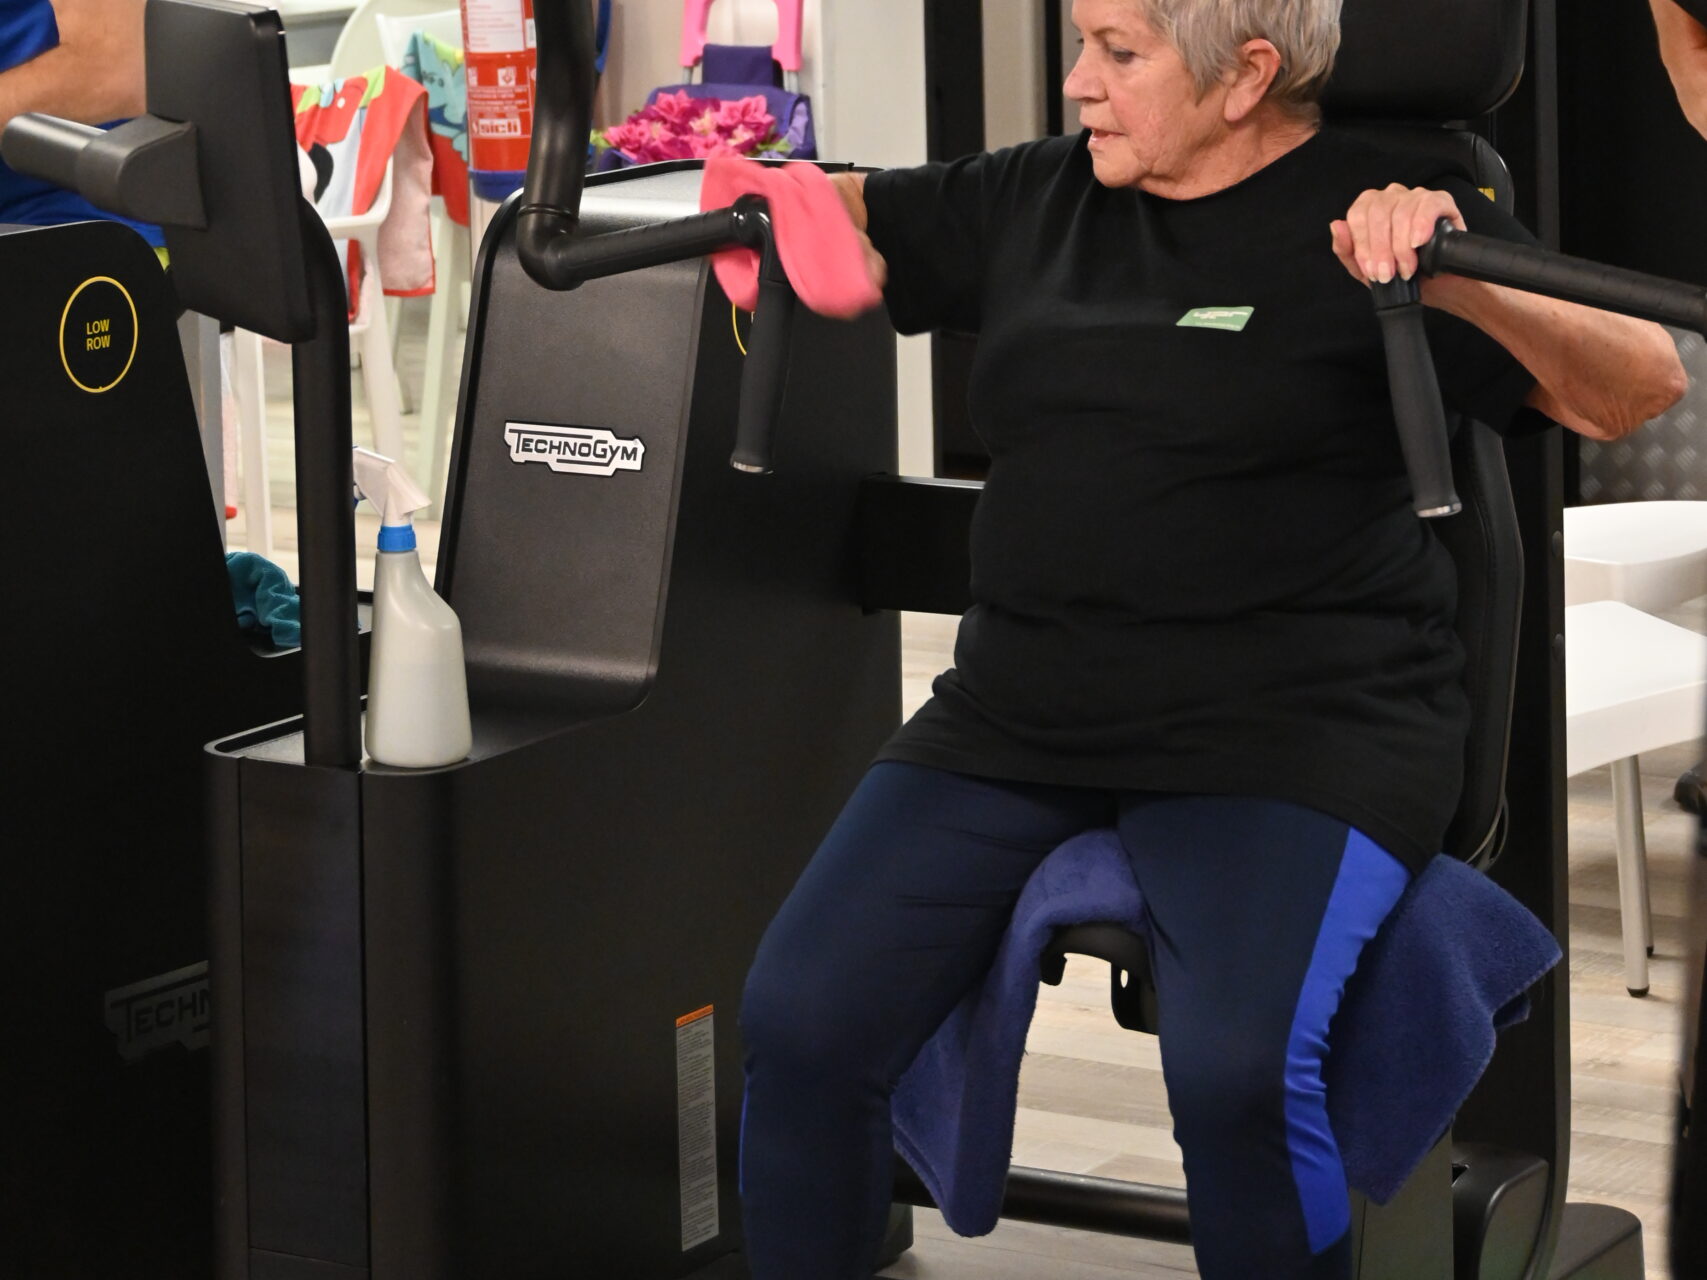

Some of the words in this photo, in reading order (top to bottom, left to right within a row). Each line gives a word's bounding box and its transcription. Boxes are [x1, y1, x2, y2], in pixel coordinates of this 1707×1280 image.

[86, 319, 110, 335] LOW
[86, 335, 111, 352] ROW
[110, 972, 209, 1044] TECHN
